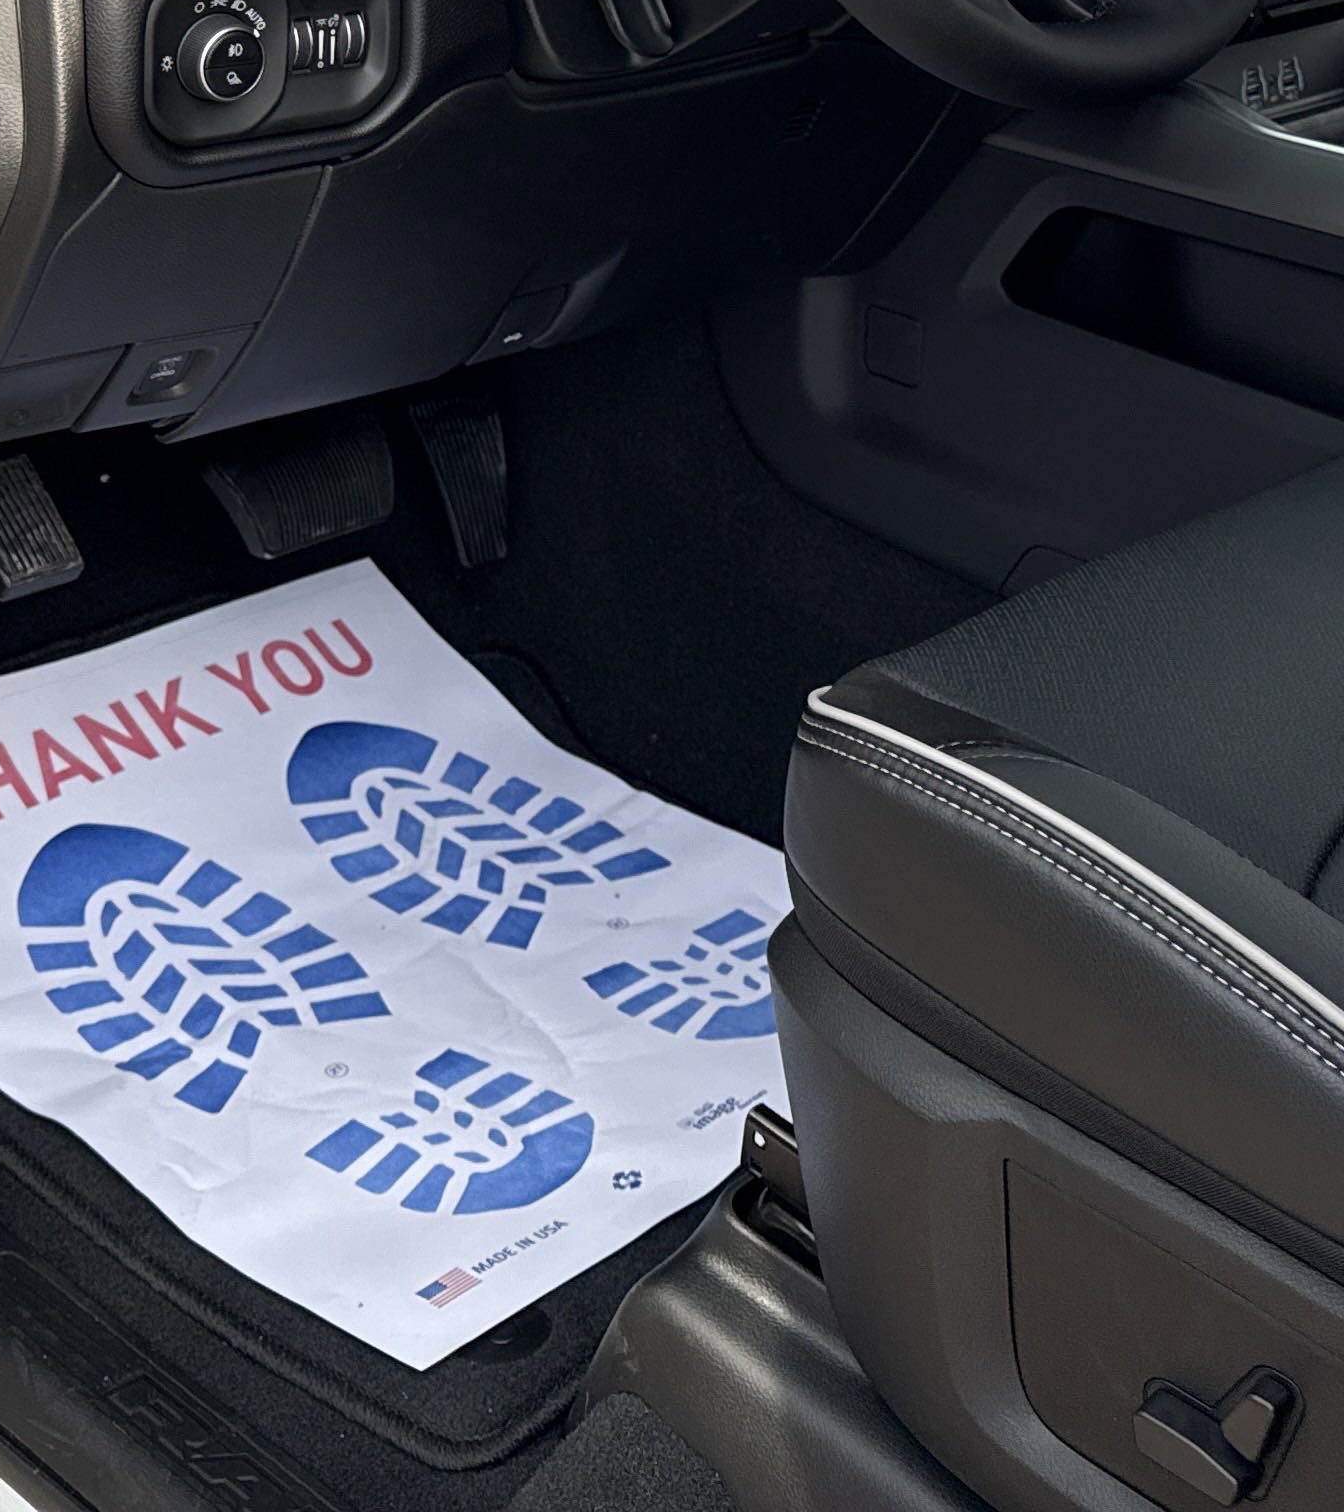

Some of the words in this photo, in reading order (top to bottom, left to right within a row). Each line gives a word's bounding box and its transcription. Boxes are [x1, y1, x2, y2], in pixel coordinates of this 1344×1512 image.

[244, 8, 267, 30] AUTO
[203, 617, 374, 716] YOU
[471, 1246, 518, 1275] MADE
[514, 1236, 537, 1251] IN
[532, 1219, 569, 1240] USA
